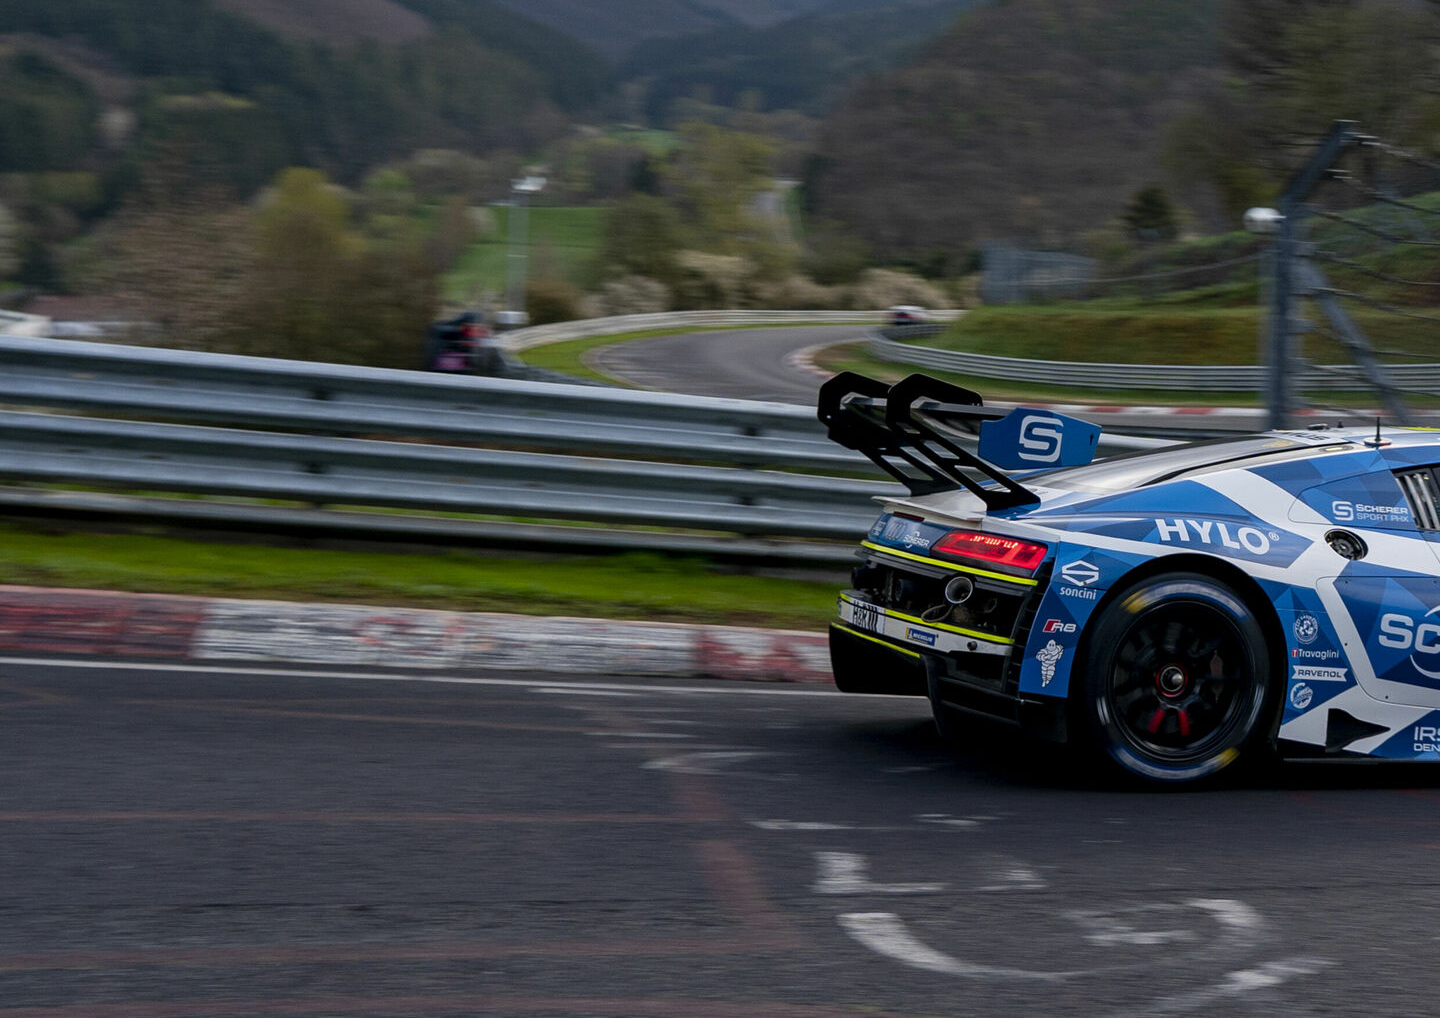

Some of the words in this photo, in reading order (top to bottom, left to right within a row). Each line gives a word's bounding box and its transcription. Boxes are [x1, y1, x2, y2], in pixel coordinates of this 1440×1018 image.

[1355, 503, 1409, 515] SCHERER
[1356, 512, 1389, 522] SPORT
[1390, 514, 1409, 523] PHX
[1155, 518, 1270, 555] HYLO
[1060, 586, 1097, 601] soncini
[1050, 622, 1077, 633] R8
[1298, 649, 1340, 660] Travaglini
[1297, 669, 1342, 678] RAVENOL
